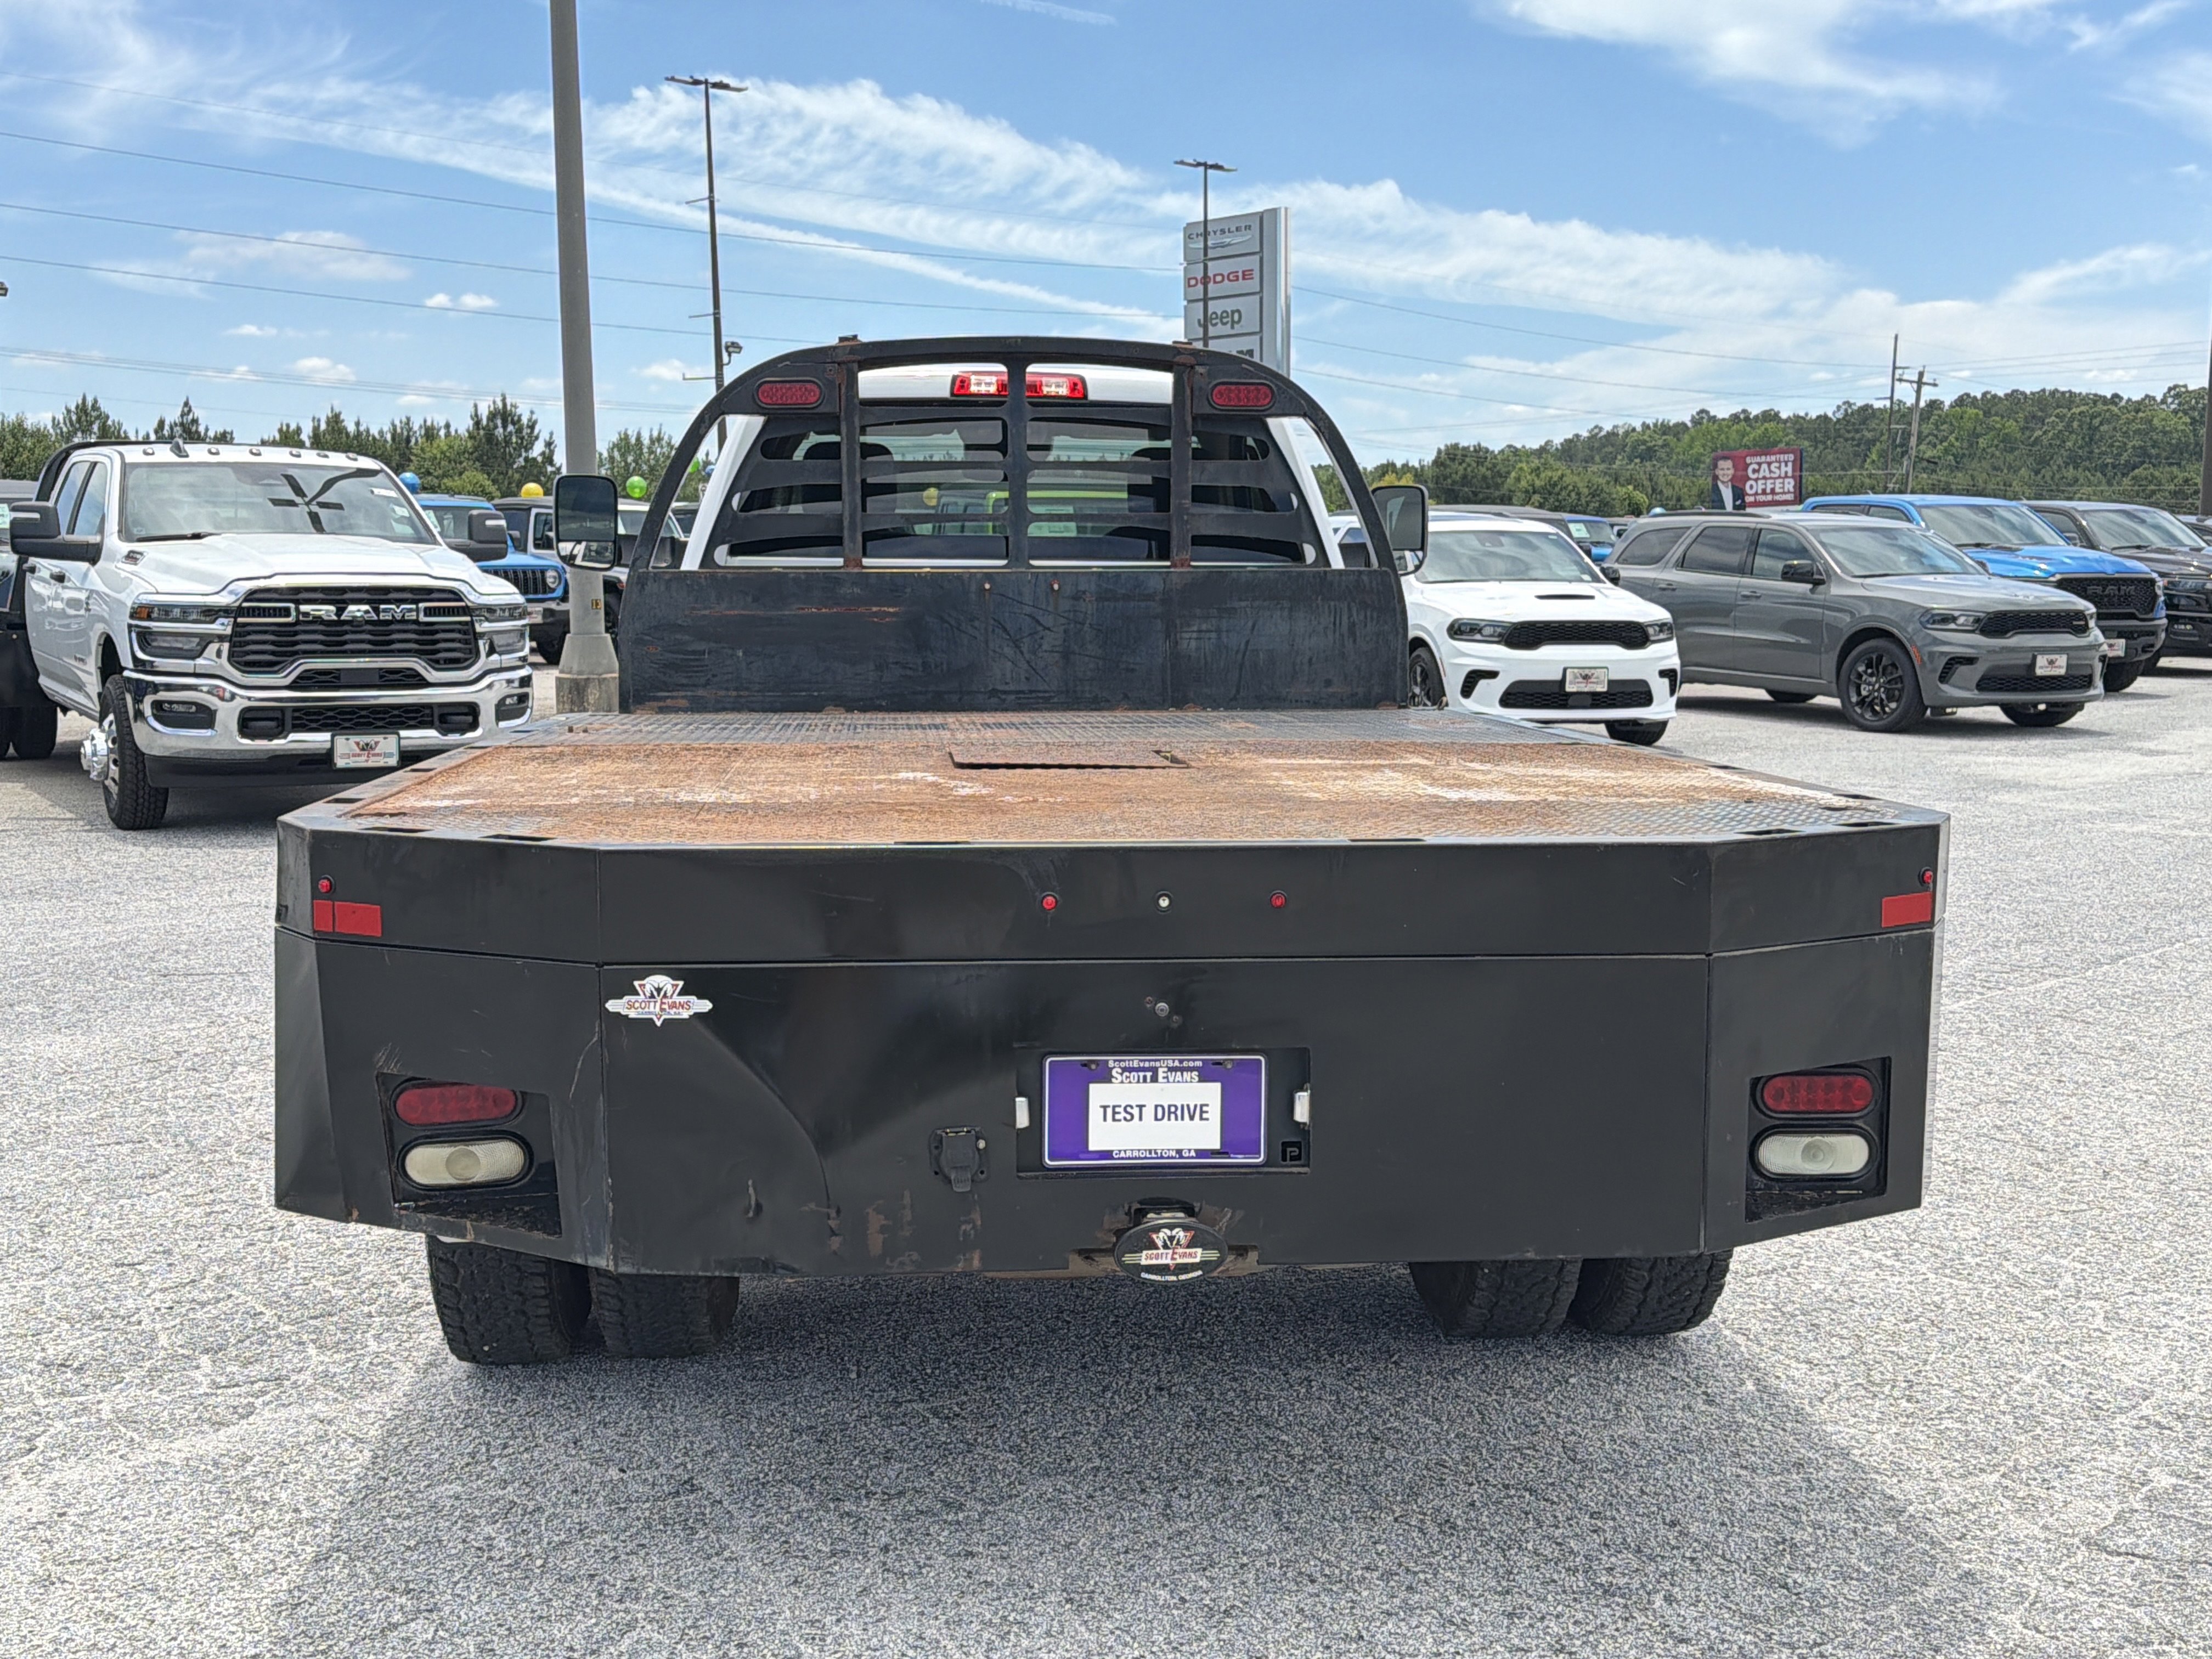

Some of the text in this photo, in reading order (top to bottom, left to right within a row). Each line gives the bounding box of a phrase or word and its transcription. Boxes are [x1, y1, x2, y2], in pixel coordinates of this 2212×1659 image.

[1187, 269, 1254, 288] DODGE
[1746, 454, 1794, 464] GUARANTEED
[1747, 461, 1792, 479] CASH
[1745, 478, 1795, 494] OFFER
[299, 605, 416, 620] RAM
[626, 997, 691, 1012] SCOTT EVANS
[1099, 1103, 1210, 1122] TEST DRIVE
[1144, 1246, 1198, 1261] SCOTT EVANS
